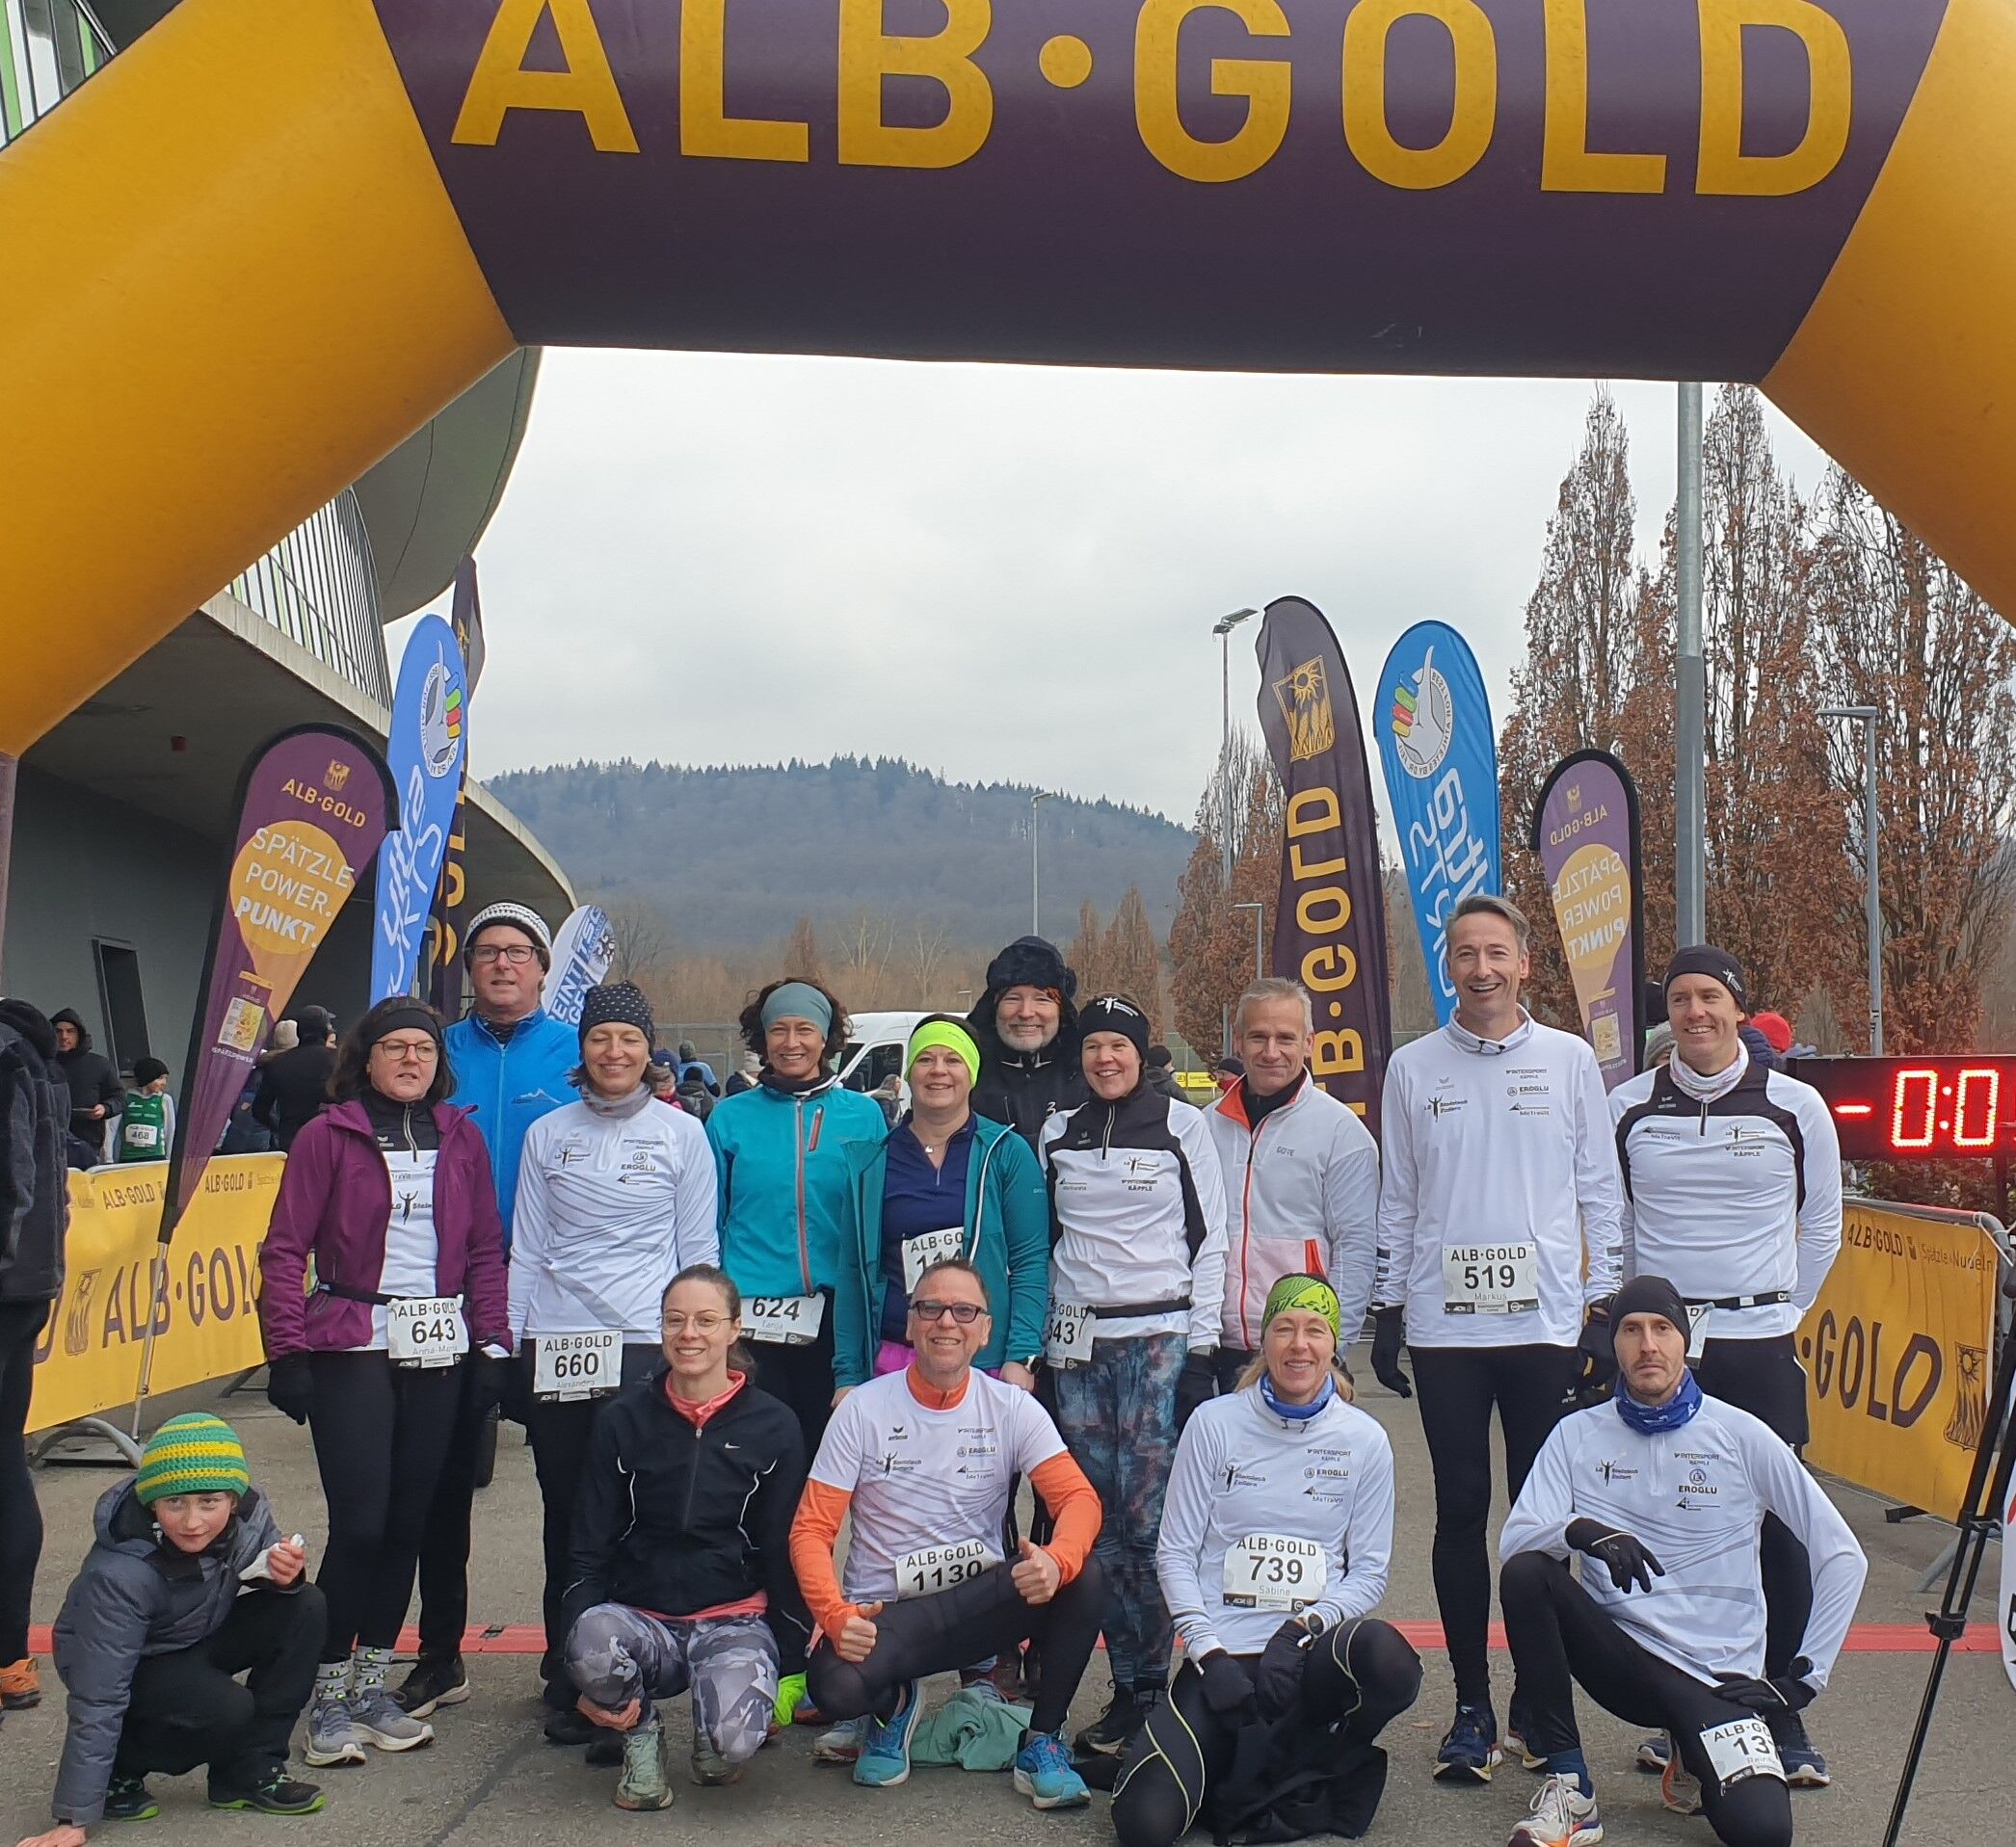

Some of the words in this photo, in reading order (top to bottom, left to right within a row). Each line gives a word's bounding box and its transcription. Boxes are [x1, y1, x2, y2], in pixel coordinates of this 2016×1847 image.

[252, 827, 355, 888] SPÄTZLE
[246, 861, 333, 917] POWER.
[911, 1231, 964, 1253] ALB·GO
[1450, 1246, 1526, 1262] ALB·GOLD
[1464, 1264, 1516, 1290] 519
[398, 1302, 457, 1318] ALB·GOLD
[753, 1296, 802, 1321] 624
[411, 1317, 456, 1344] 643
[544, 1334, 613, 1353] ALB·GOLD
[554, 1352, 599, 1378] 660
[906, 1541, 985, 1569] ALB·GOLD
[1236, 1537, 1317, 1557] ALB·GOLD
[913, 1559, 984, 1592] 1130
[1249, 1555, 1304, 1584] 739
[1713, 1722, 1771, 1743] ALB·GO
[1733, 1735, 1779, 1760] 13
